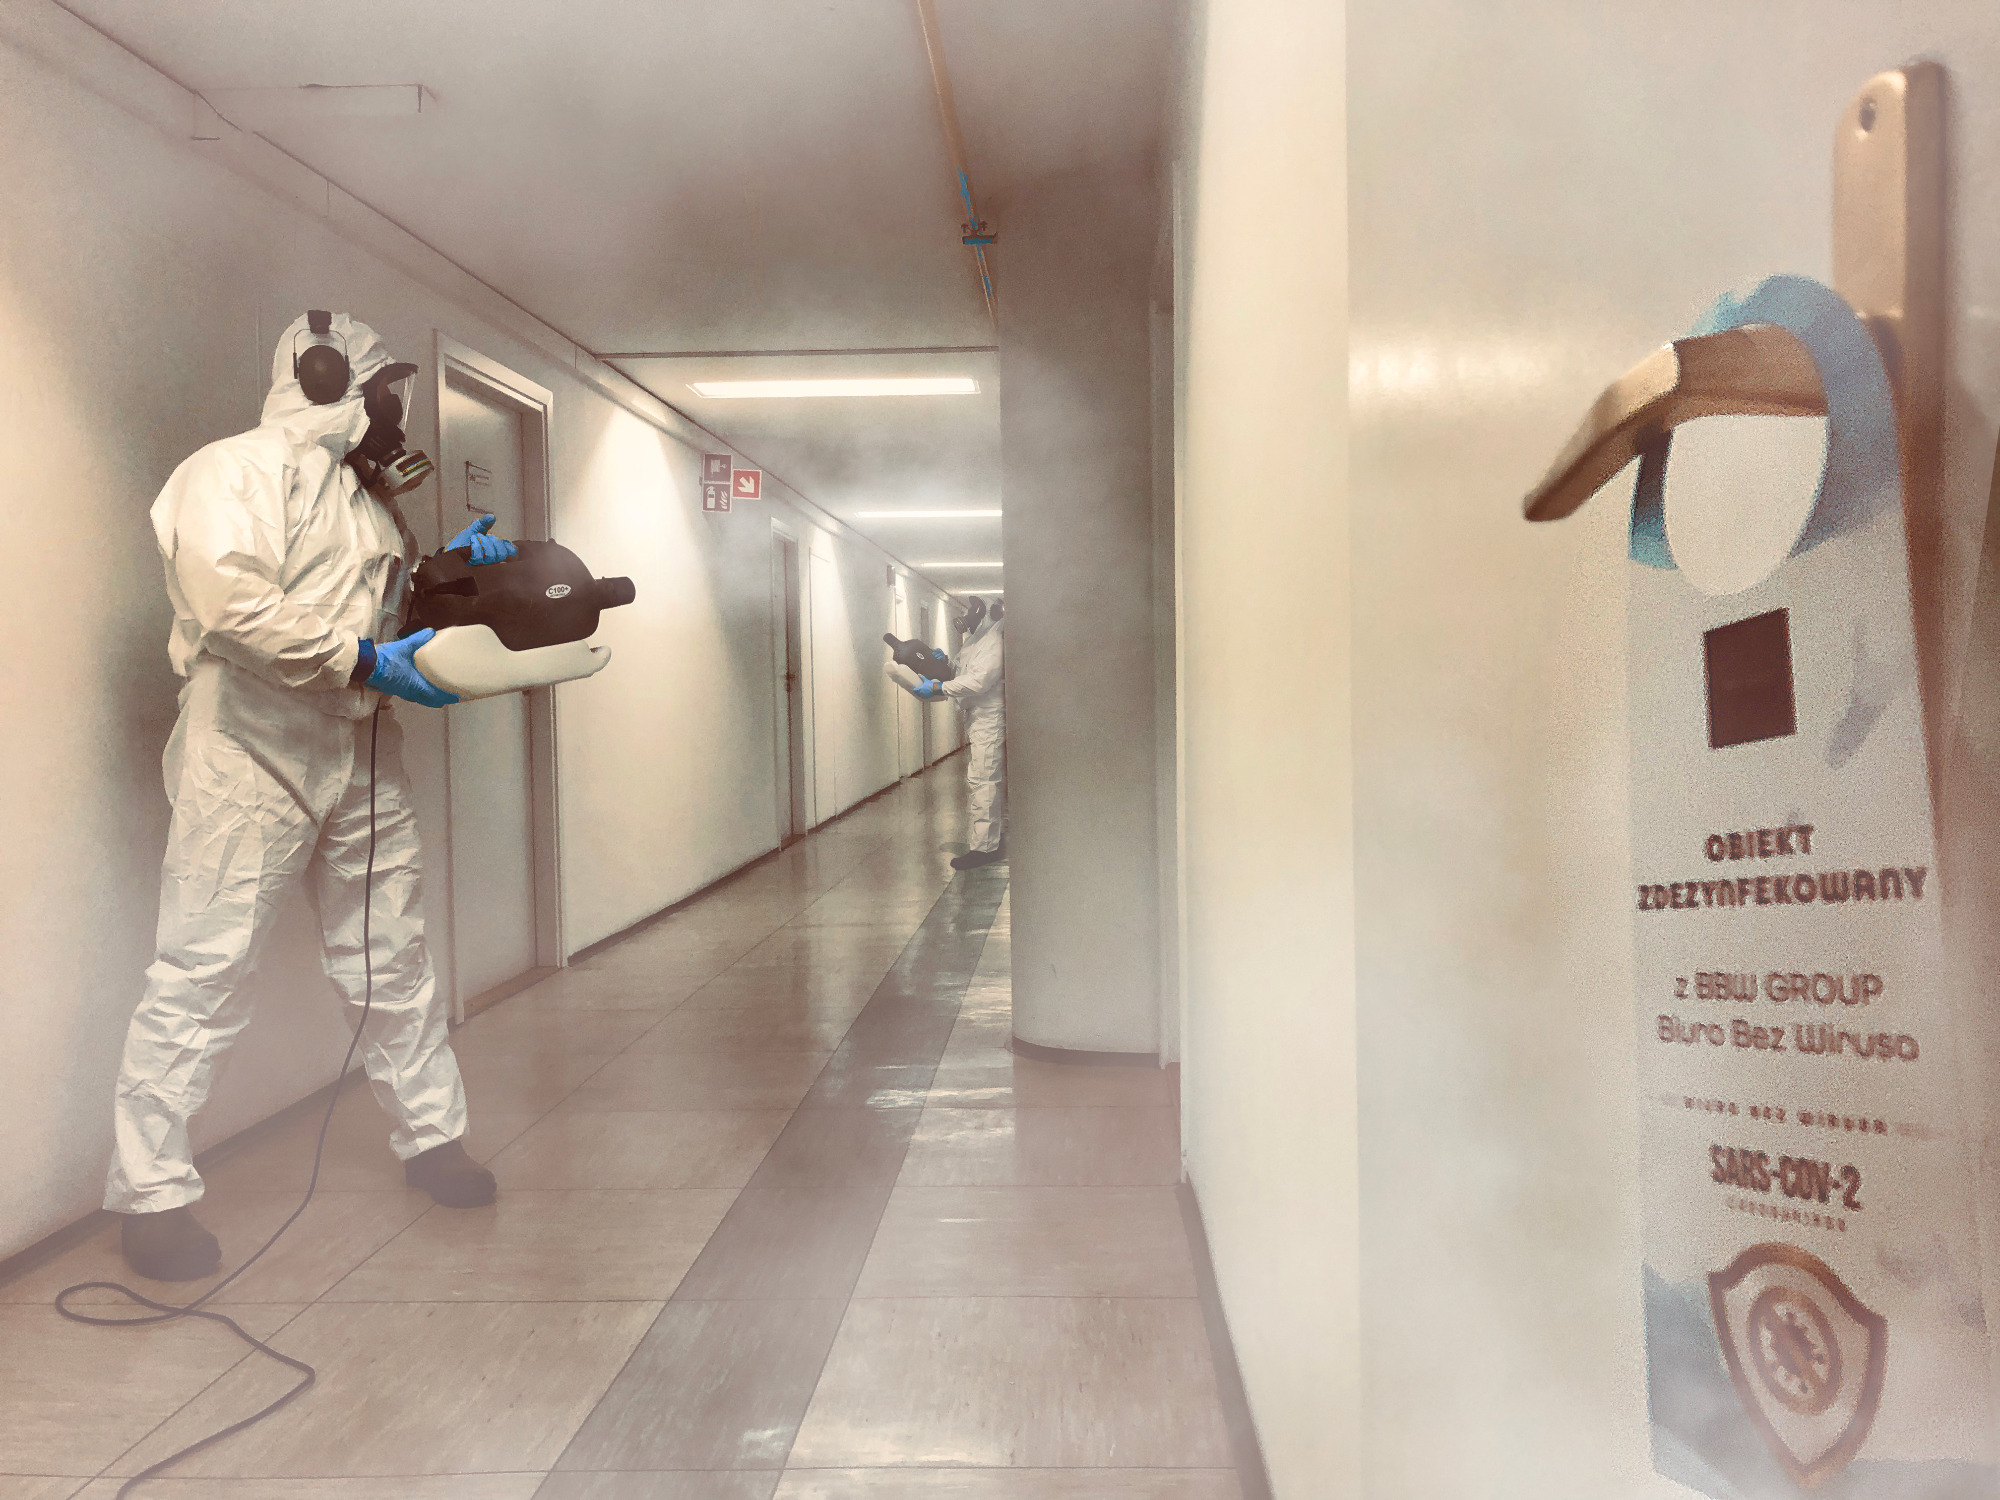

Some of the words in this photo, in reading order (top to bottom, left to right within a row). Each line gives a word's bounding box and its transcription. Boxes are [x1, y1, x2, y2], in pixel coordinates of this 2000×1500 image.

[548, 586, 569, 595] C100+
[1704, 824, 1814, 862] OBIEKT
[1637, 866, 1928, 911] ZDEZYNFEKOWANY
[1764, 971, 1884, 1006] GROUP
[1731, 1018, 1787, 1051] Bez
